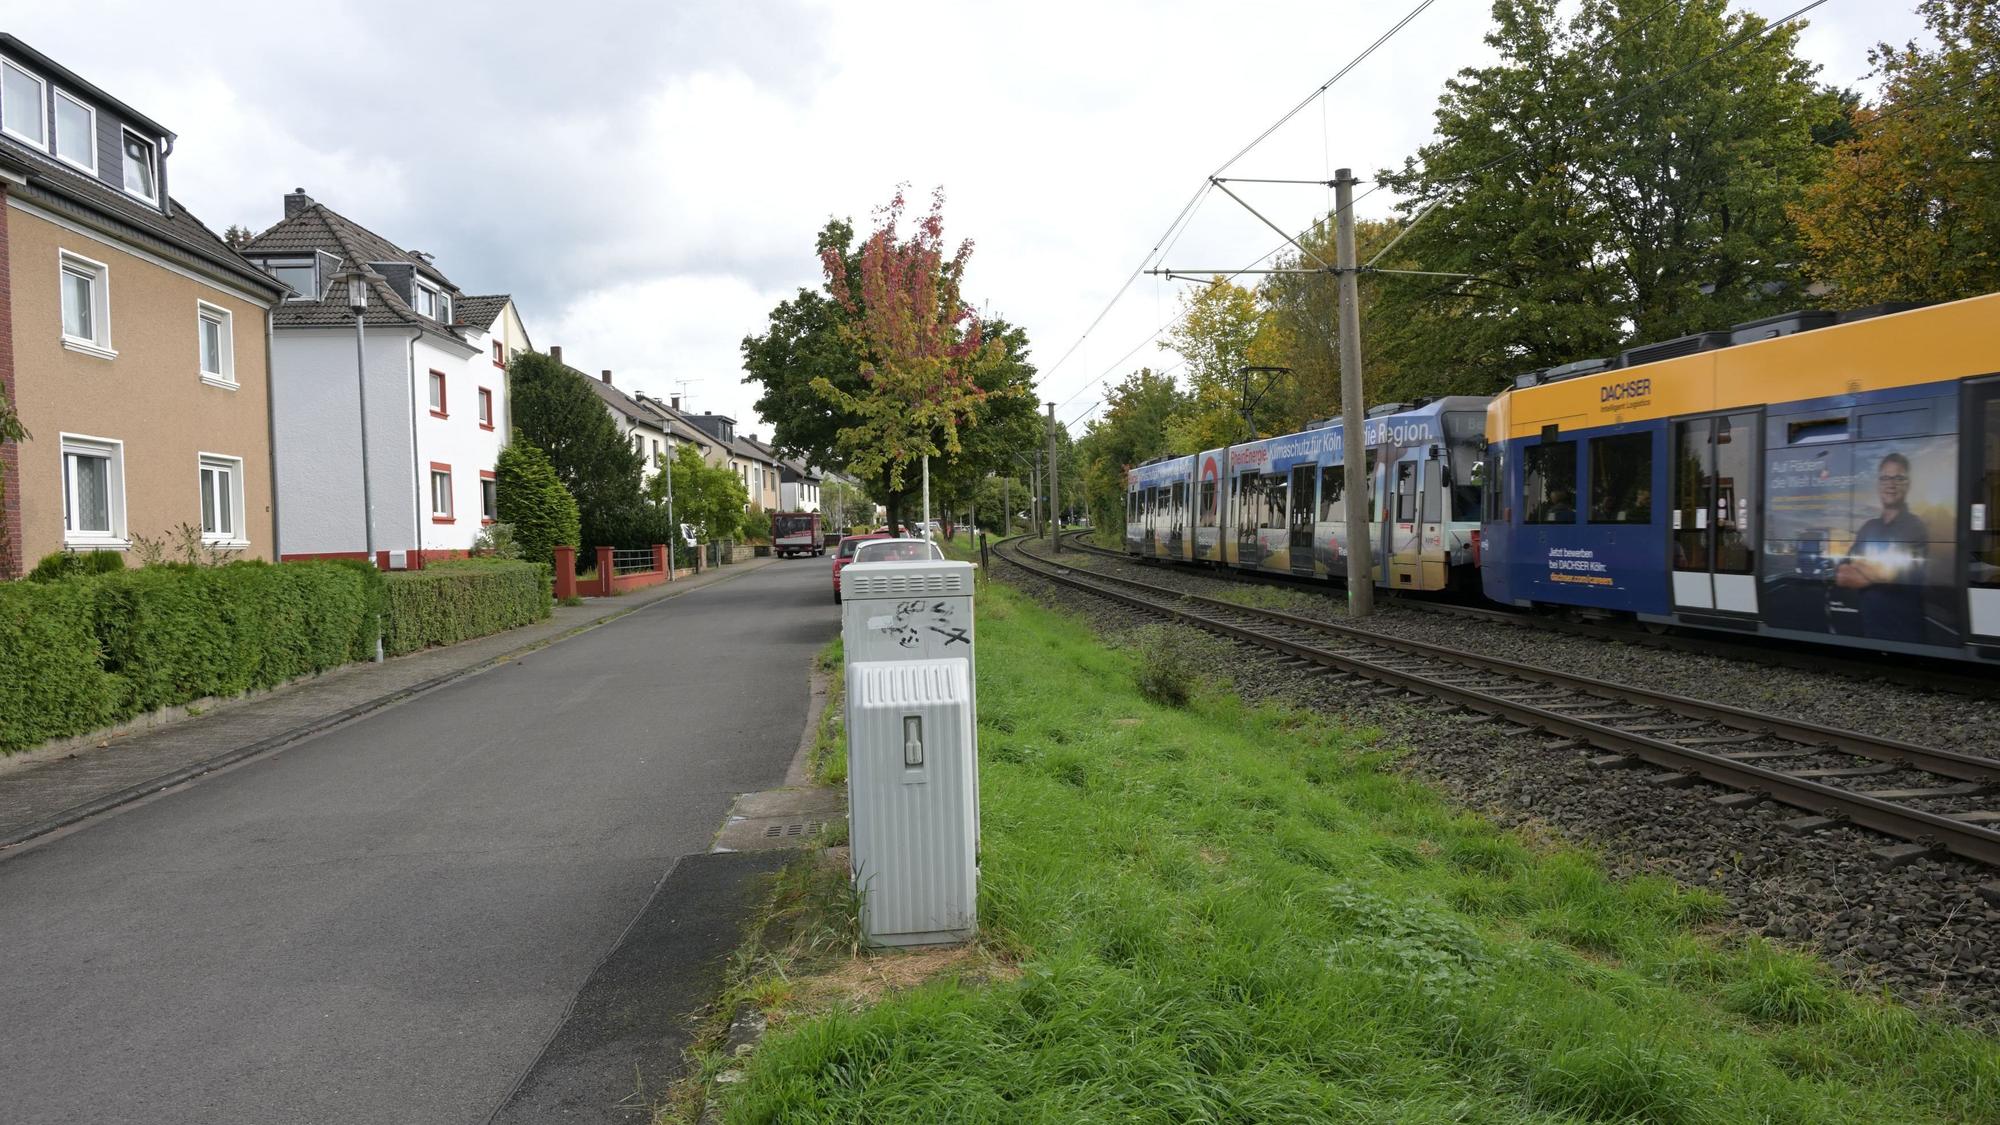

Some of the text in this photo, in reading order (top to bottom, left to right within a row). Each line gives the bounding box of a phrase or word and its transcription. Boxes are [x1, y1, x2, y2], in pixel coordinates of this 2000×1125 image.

[1600, 378, 1651, 402] DACHSER
[1269, 439, 1311, 460] Klimaschutz
[1311, 435, 1322, 455] für
[1323, 431, 1342, 452] Köln
[1377, 420, 1433, 448] Region.
[1564, 548, 1593, 558] bewerben
[1549, 560, 1558, 569] bei
[1559, 560, 1589, 571] DACHSER
